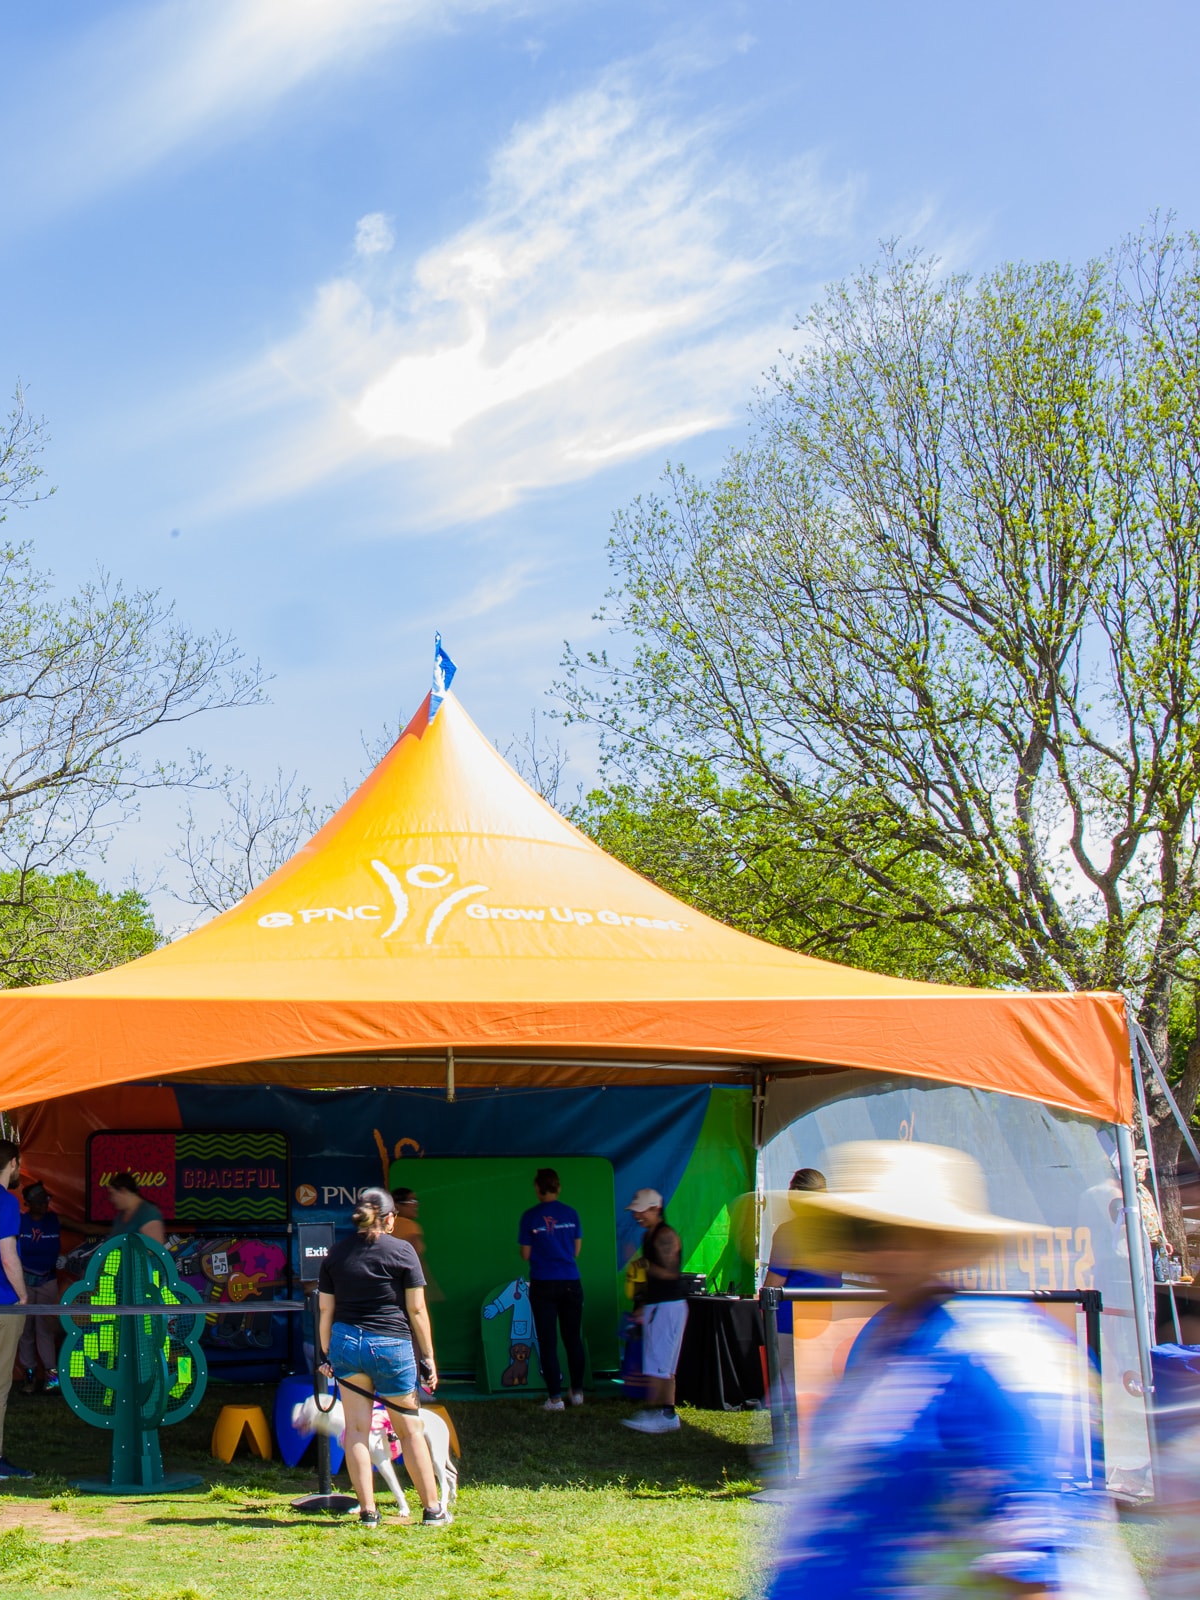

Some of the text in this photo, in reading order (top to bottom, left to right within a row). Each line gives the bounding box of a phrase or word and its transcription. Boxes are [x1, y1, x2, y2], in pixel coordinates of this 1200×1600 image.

[298, 904, 381, 921] PNC
[466, 903, 685, 931] Grow Up Great
[183, 1168, 281, 1189] GRACEFUL
[305, 1247, 329, 1257] Exit
